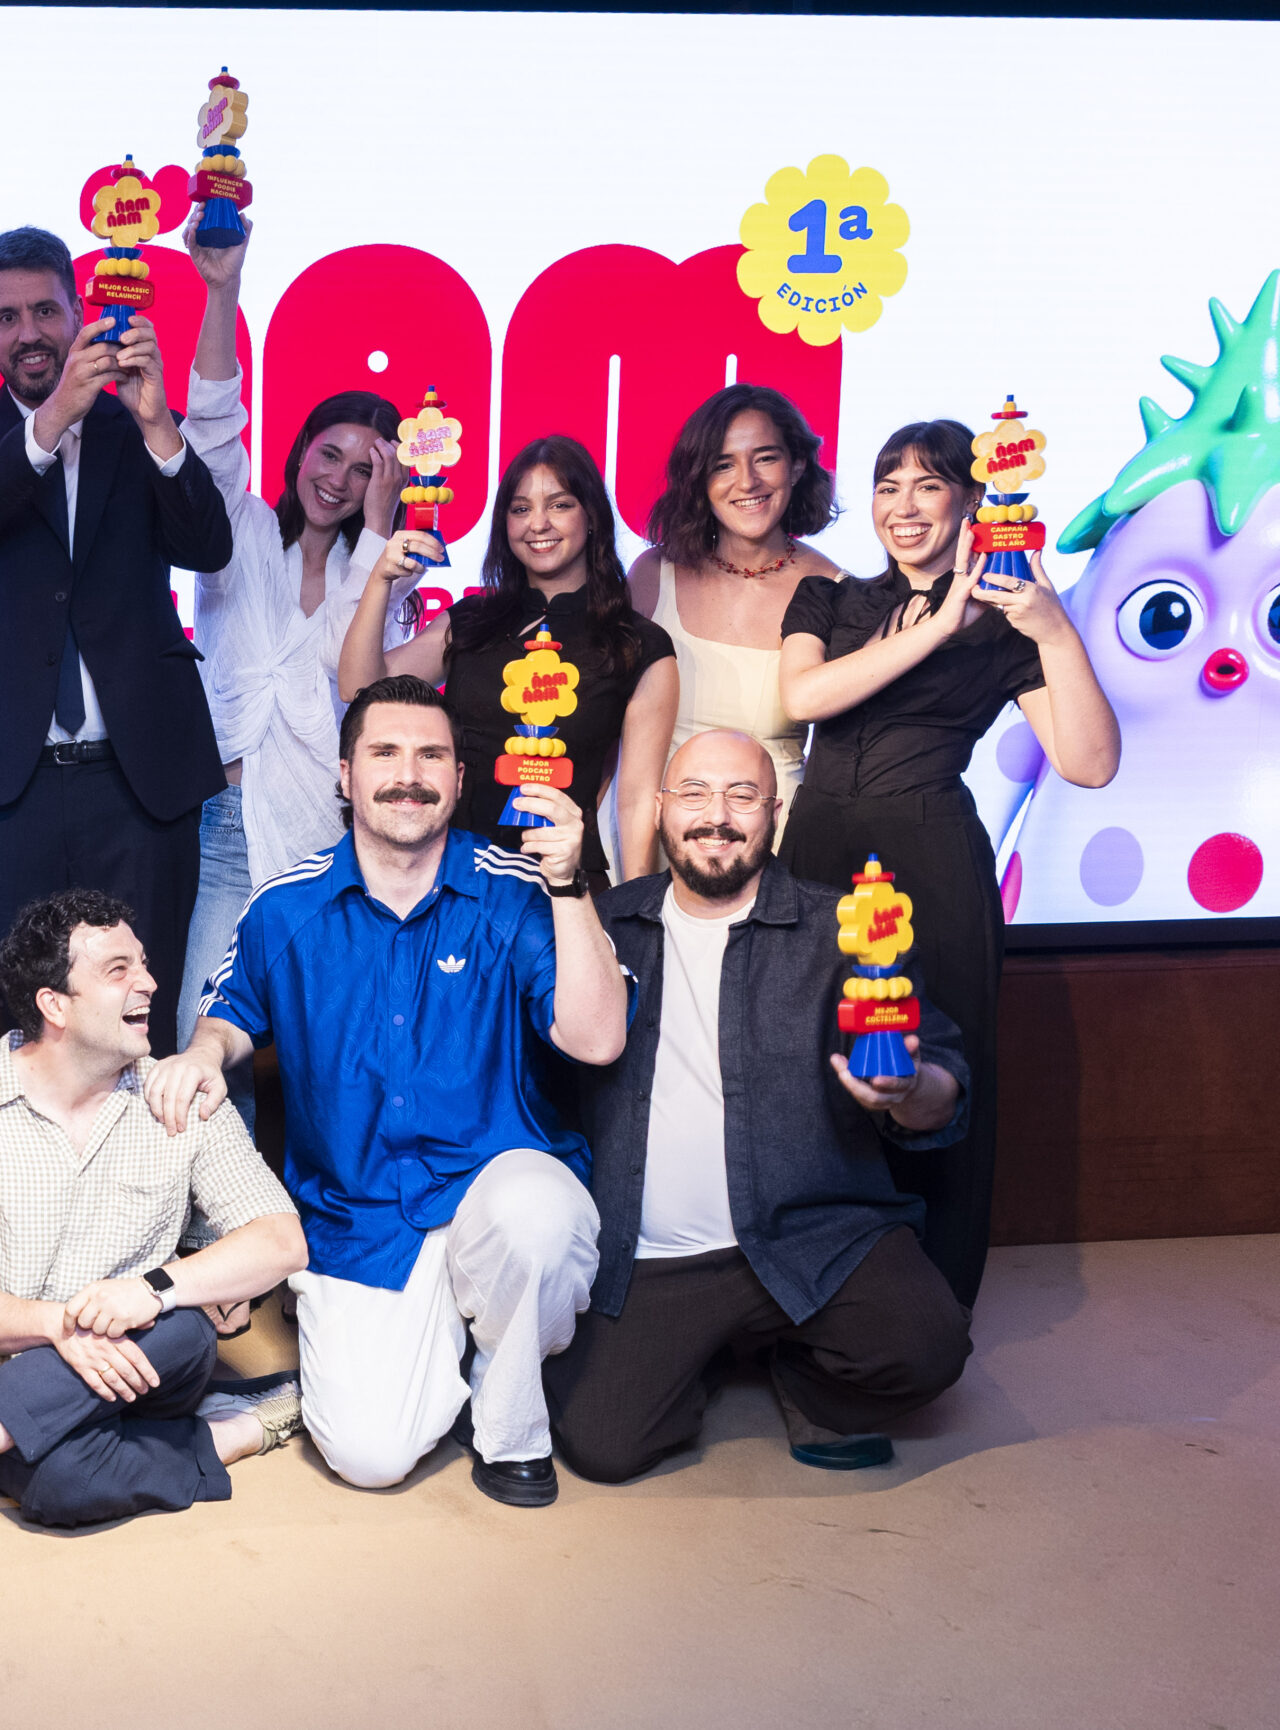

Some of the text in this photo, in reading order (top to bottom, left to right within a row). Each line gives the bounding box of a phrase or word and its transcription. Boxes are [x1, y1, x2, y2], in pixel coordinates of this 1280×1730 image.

[207, 175, 243, 187] INFLUENCER
[210, 188, 240, 200] NACIONAL
[98, 283, 150, 294] MEJOR CLASSIC
[106, 292, 142, 300] RELAUNCH
[776, 282, 869, 314] EDICIÓN
[990, 525, 1028, 533] CAMPAÑA
[1008, 539, 1026, 547] AÑO
[518, 767, 554, 775] PODCAST
[520, 774, 550, 782] GASTRO
